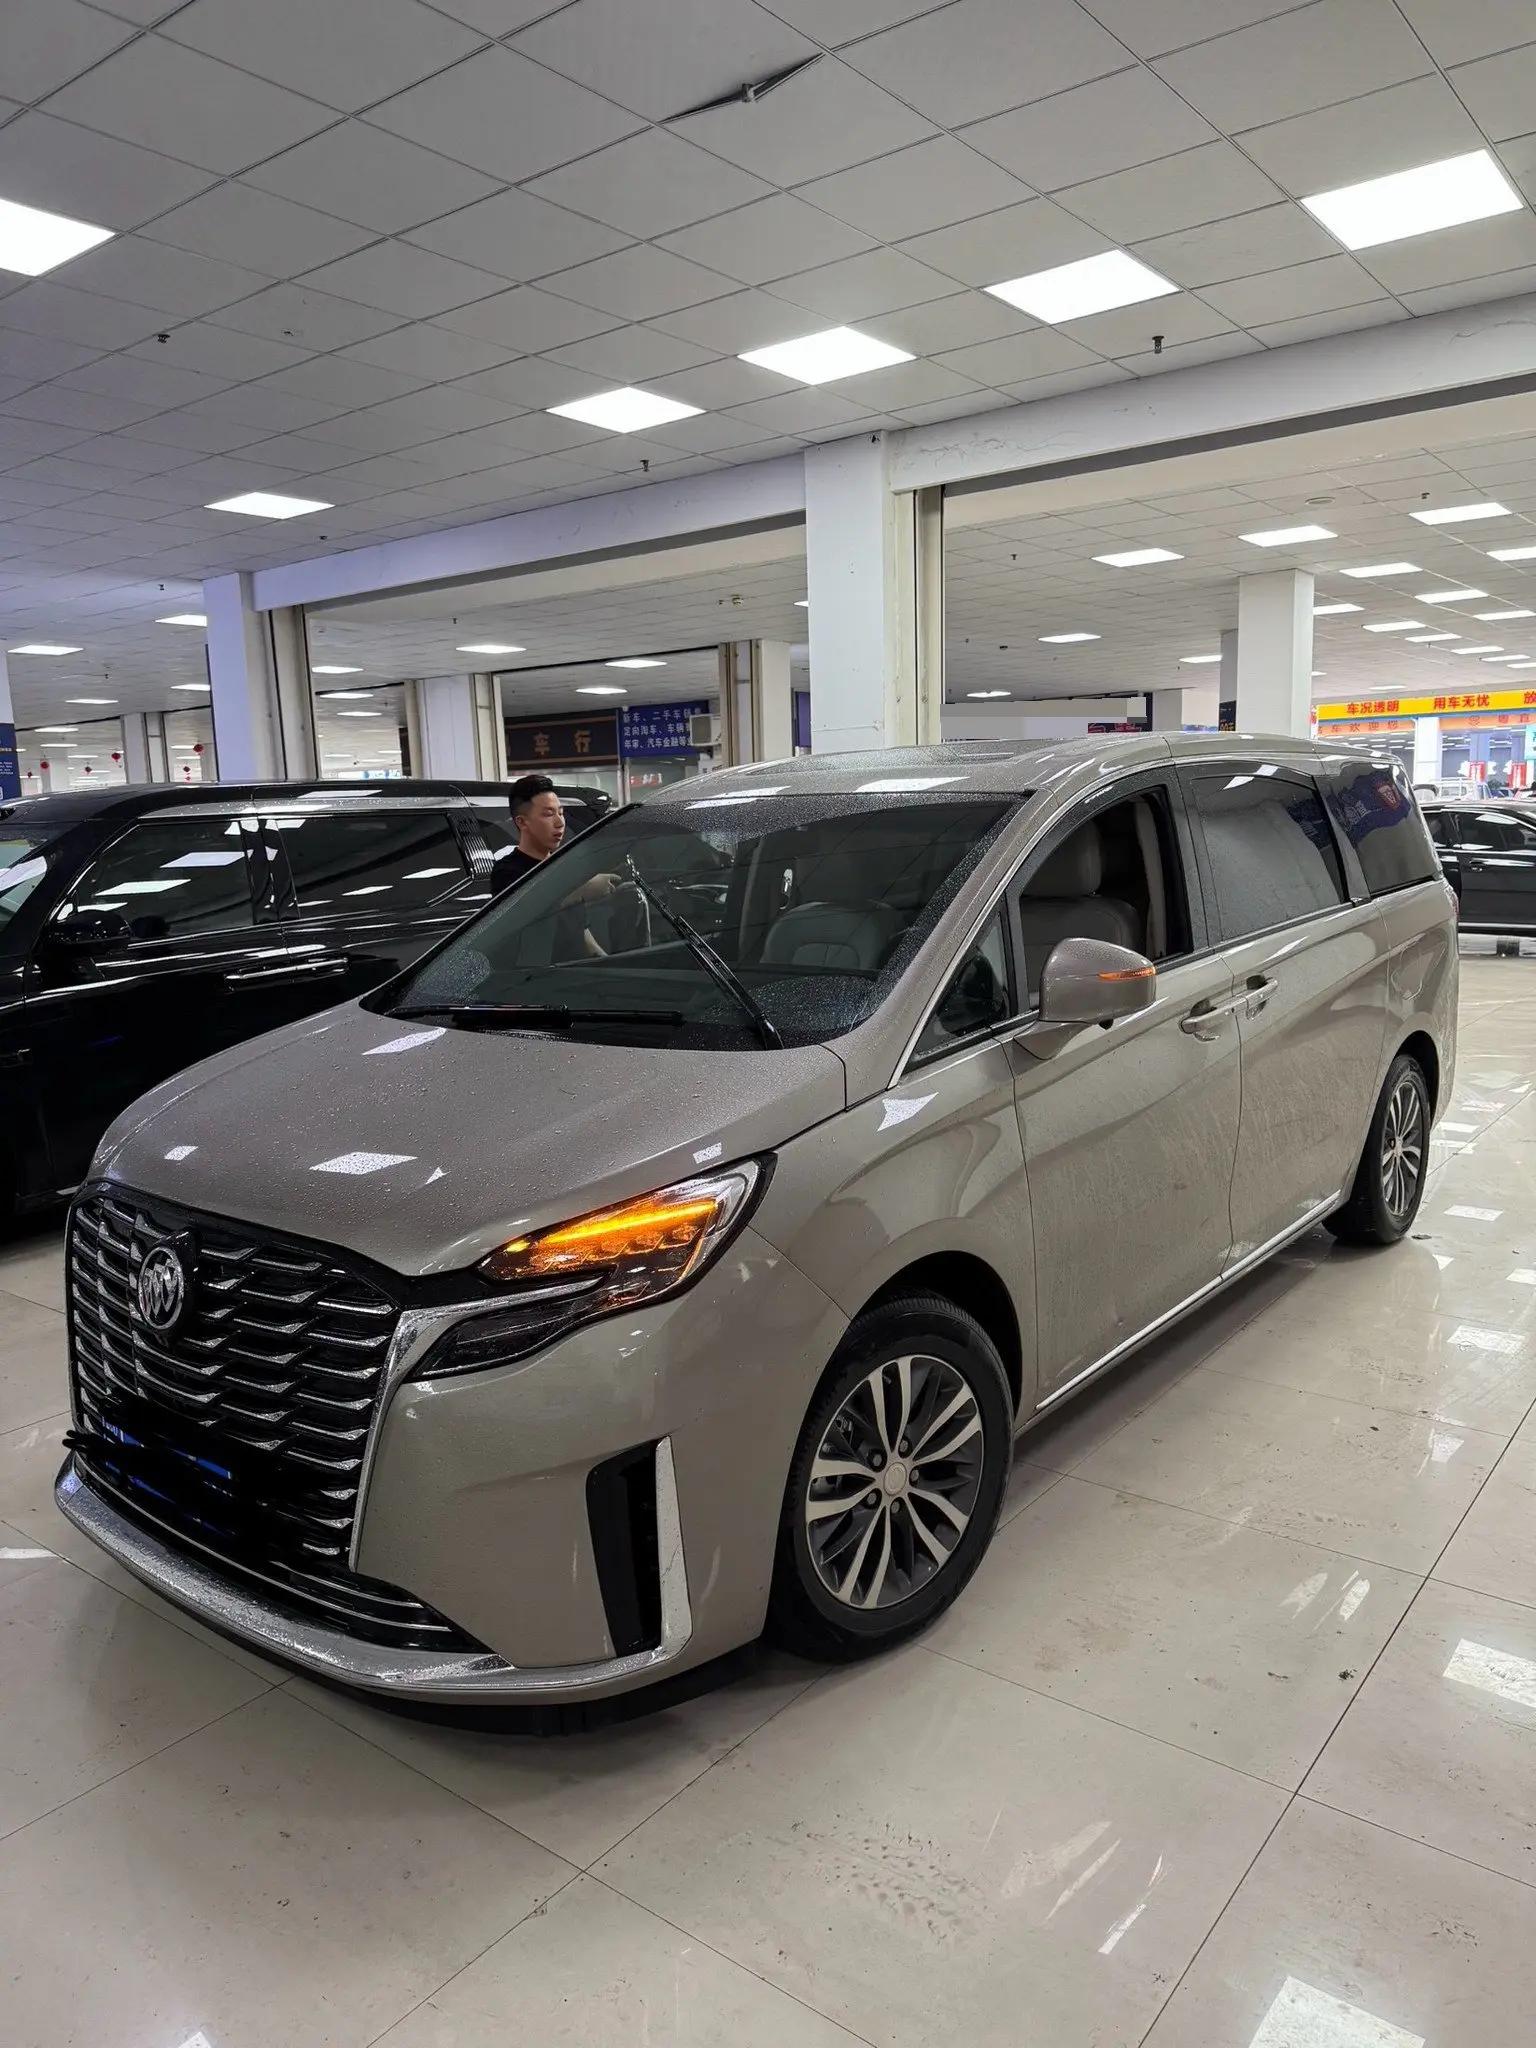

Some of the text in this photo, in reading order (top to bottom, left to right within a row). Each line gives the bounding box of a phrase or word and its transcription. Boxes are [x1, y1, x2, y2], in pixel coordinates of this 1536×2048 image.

[1346, 699, 1400, 715] 车况透明
[1433, 693, 1490, 710] 用车无忧
